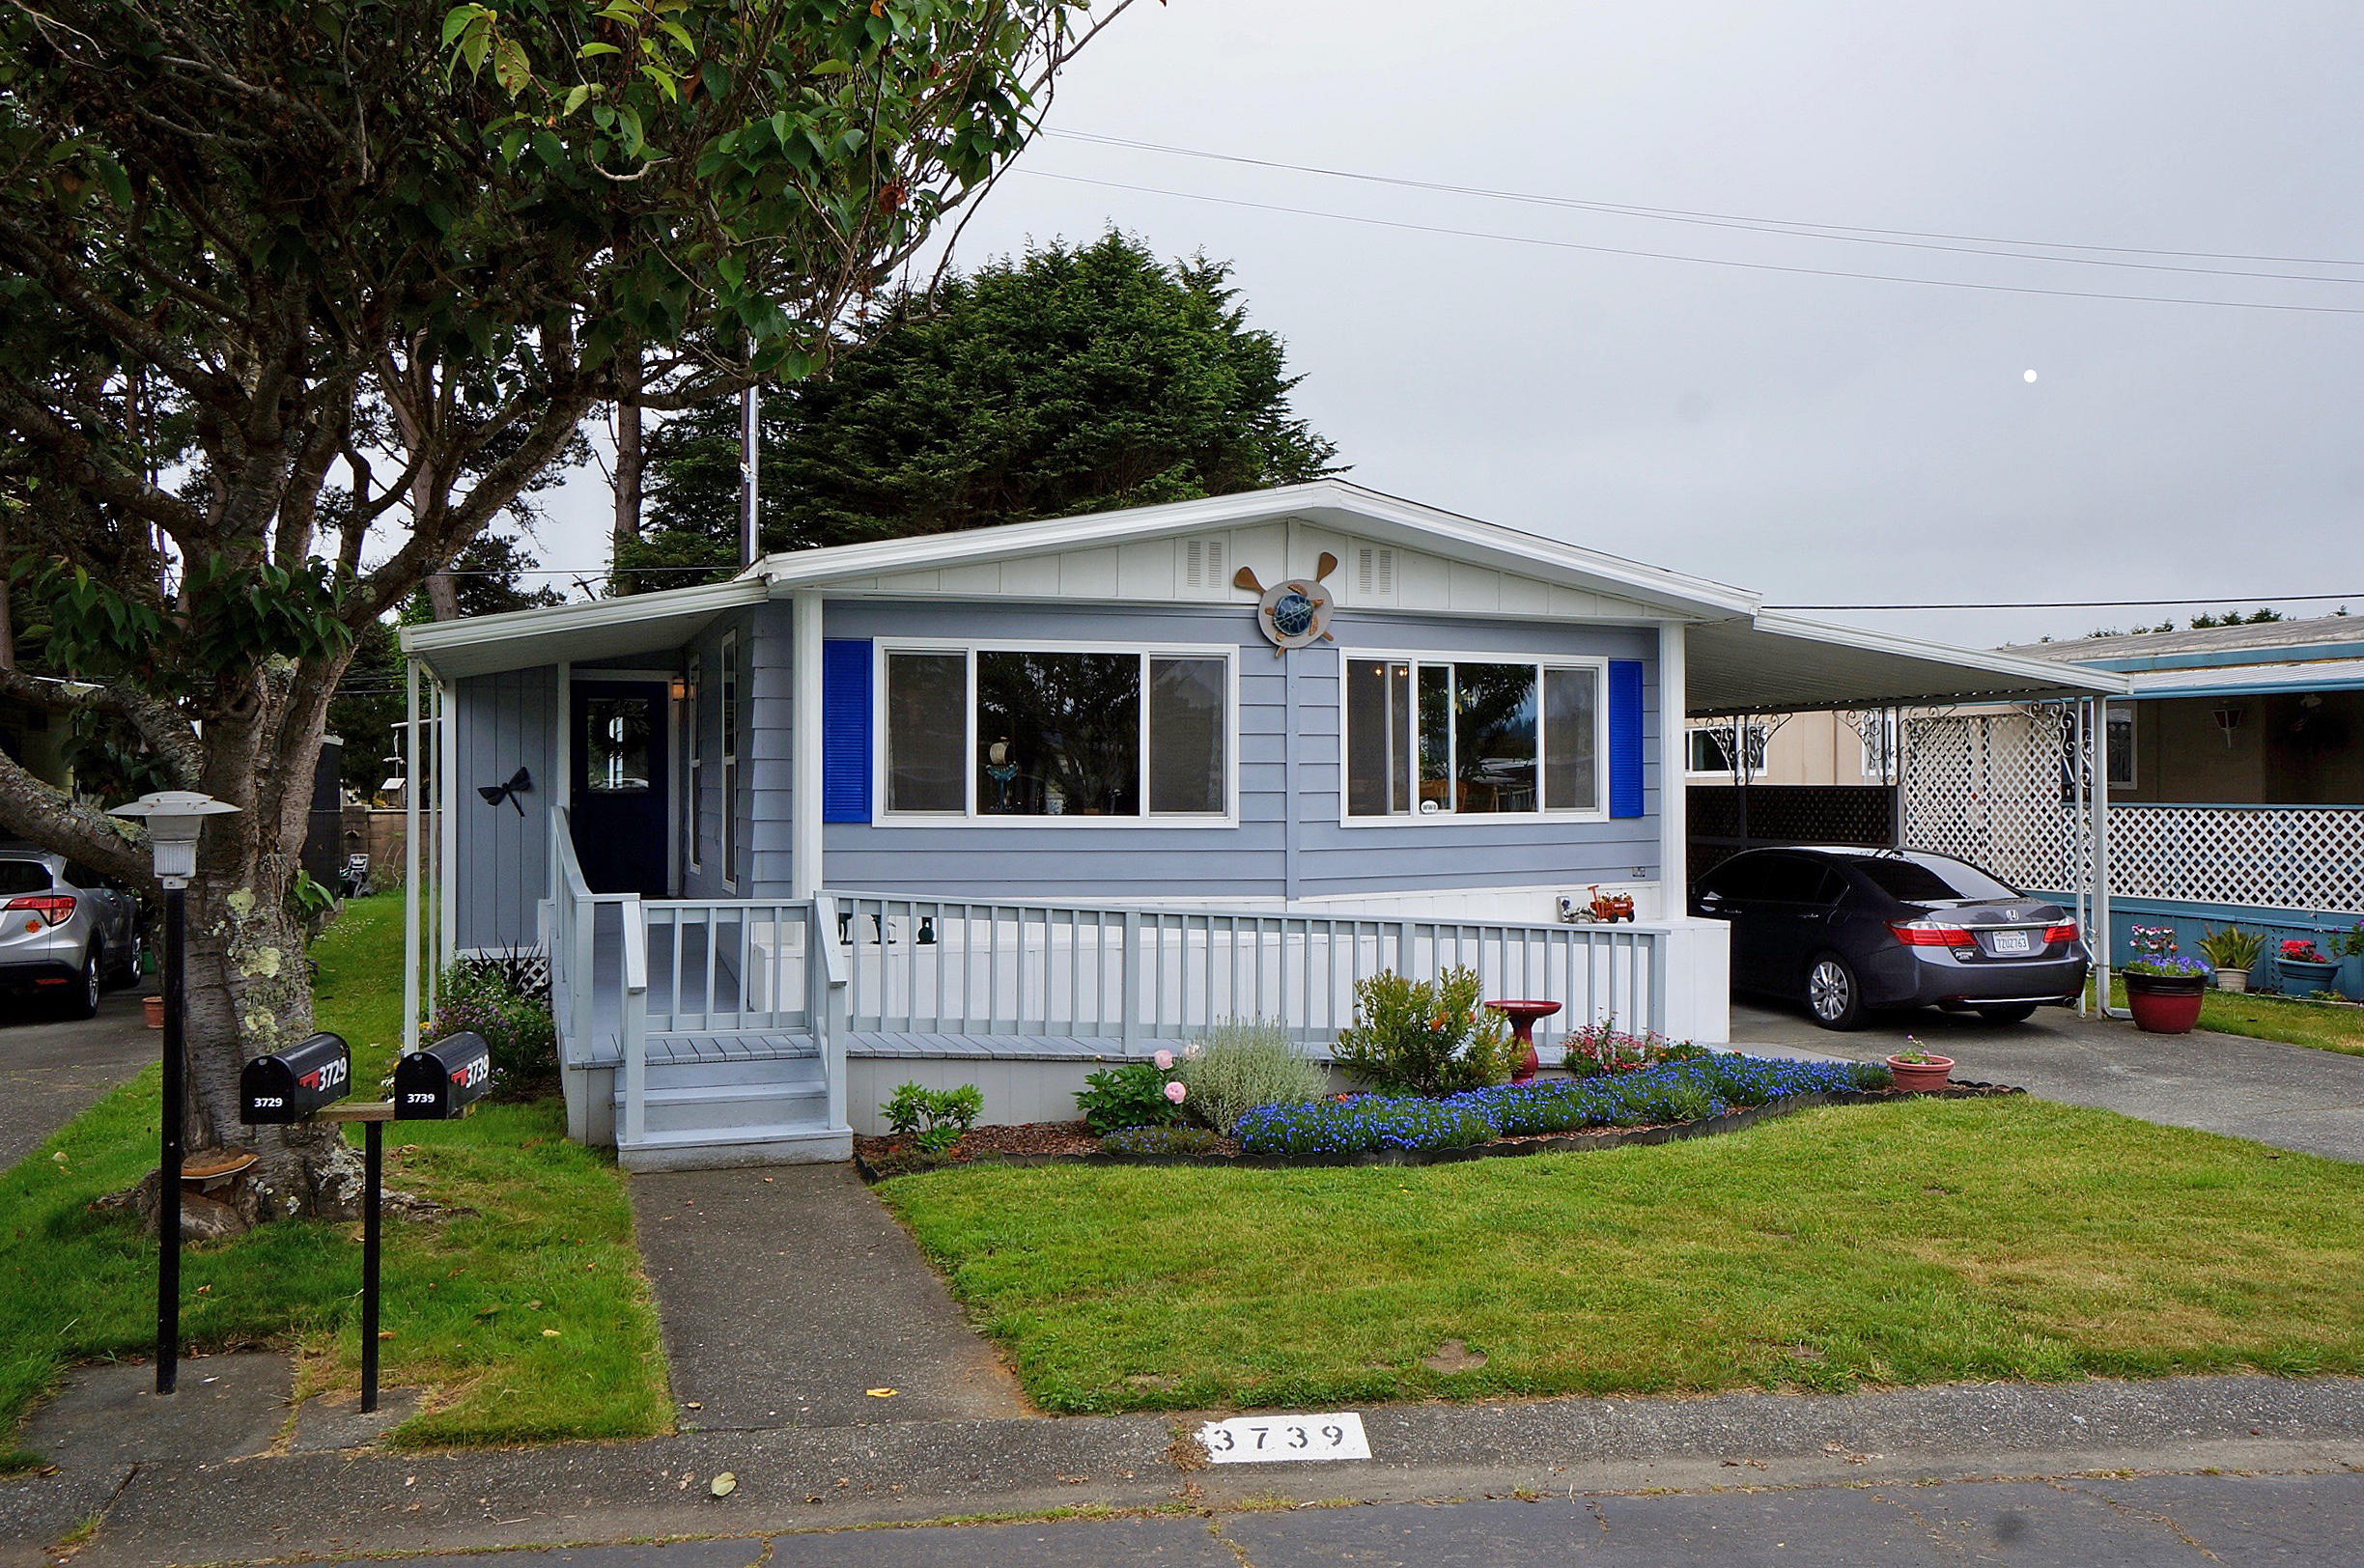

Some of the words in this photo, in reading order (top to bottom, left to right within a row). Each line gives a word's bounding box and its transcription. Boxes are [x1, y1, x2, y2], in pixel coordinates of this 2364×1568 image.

[318, 1056, 348, 1092] 3729
[465, 1053, 491, 1089] 3739
[254, 1098, 283, 1107] 3729
[407, 1093, 436, 1103] 3739
[1213, 1425, 1343, 1451] 3739
